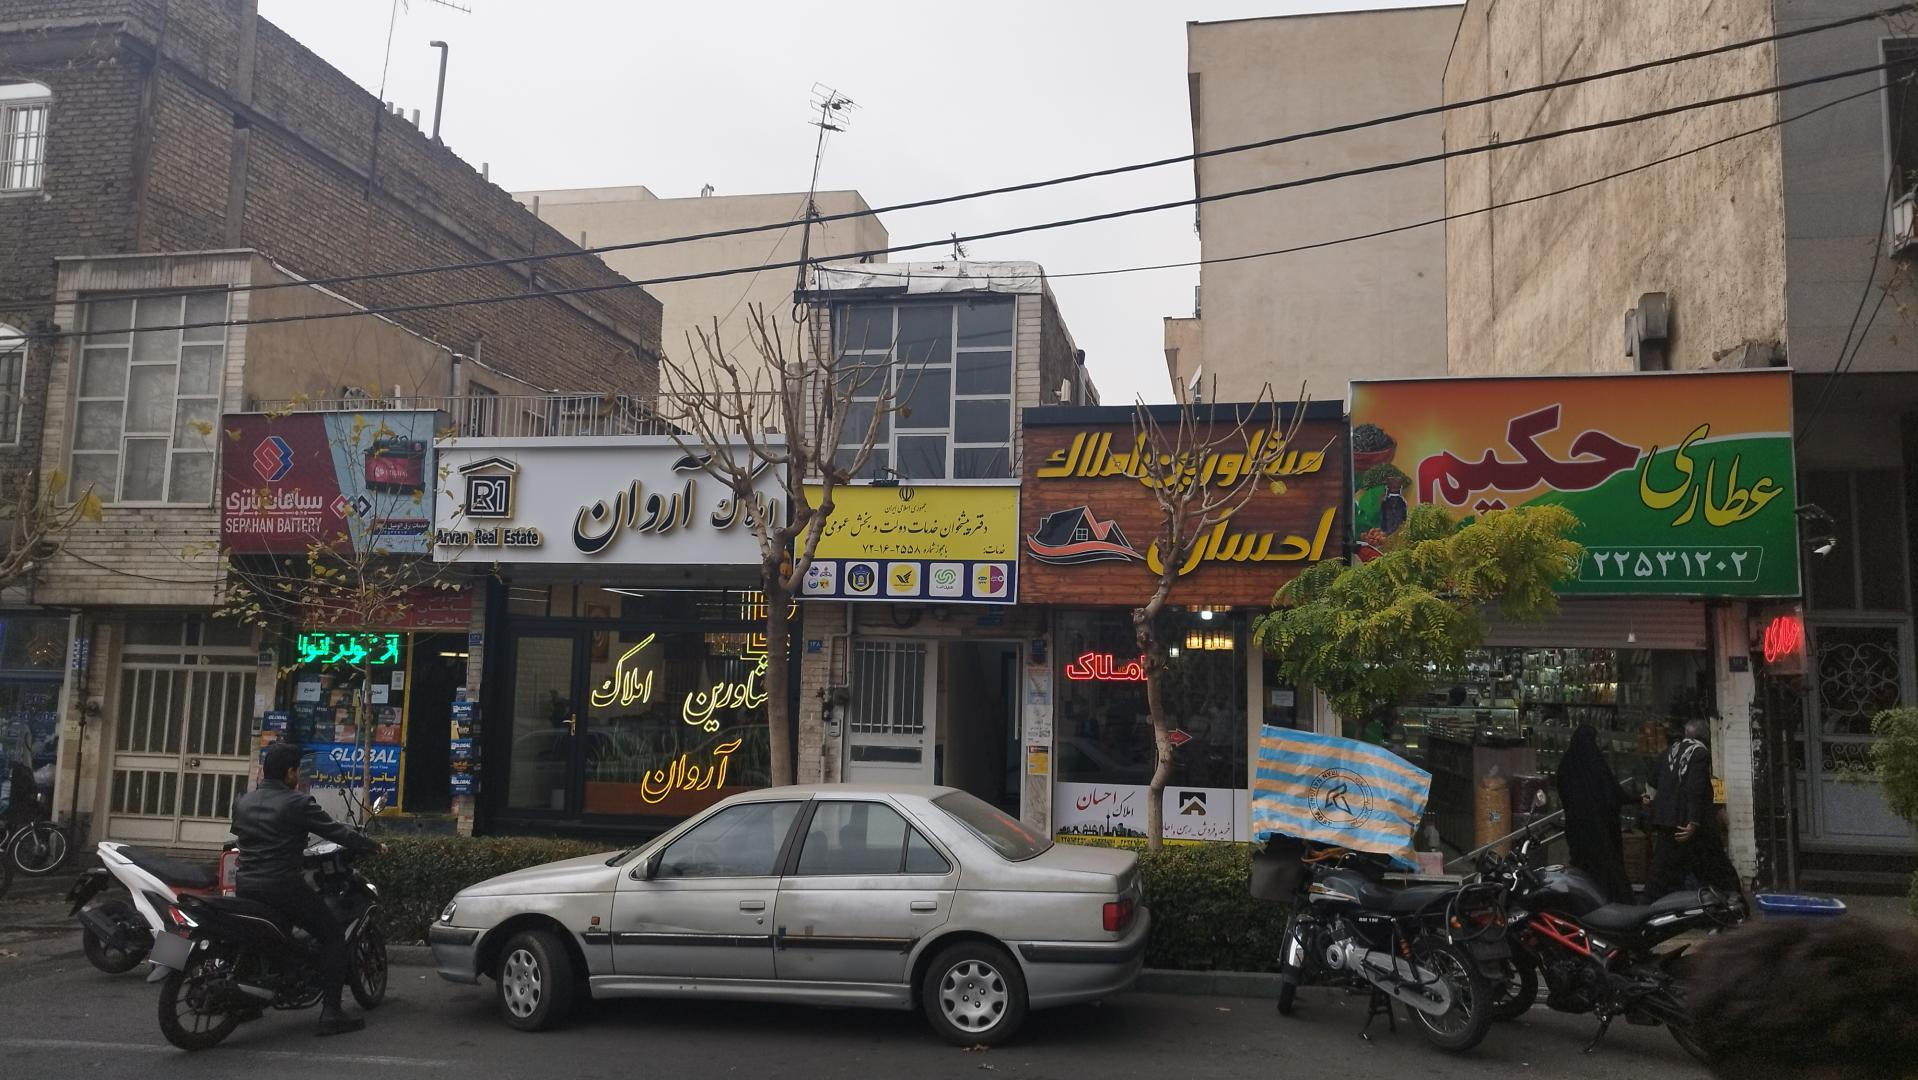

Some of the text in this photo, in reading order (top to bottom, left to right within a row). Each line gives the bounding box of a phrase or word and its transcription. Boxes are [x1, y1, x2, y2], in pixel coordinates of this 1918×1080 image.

[1417, 403, 1784, 527] عطاری حکیم
[573, 455, 713, 555] آروان
[885, 505, 897, 514] ایران
[897, 504, 911, 513] اسلامی
[226, 517, 322, 533] SEPAHAN BATTERY
[825, 517, 849, 536] عمومی
[850, 512, 872, 537] بخش
[880, 520, 907, 534] دولت
[908, 519, 938, 534] خدمات
[940, 511, 971, 537] پیشخوان
[970, 514, 988, 536] دفتر
[437, 529, 469, 546] Arvan
[475, 529, 498, 545] Real
[504, 529, 539, 546] Estate
[1594, 551, 1748, 577] ۲۲۵۳۱۲۰۲
[641, 738, 743, 804] آروان
[1076, 787, 1118, 811] احسان
[1113, 792, 1134, 817] املاک
